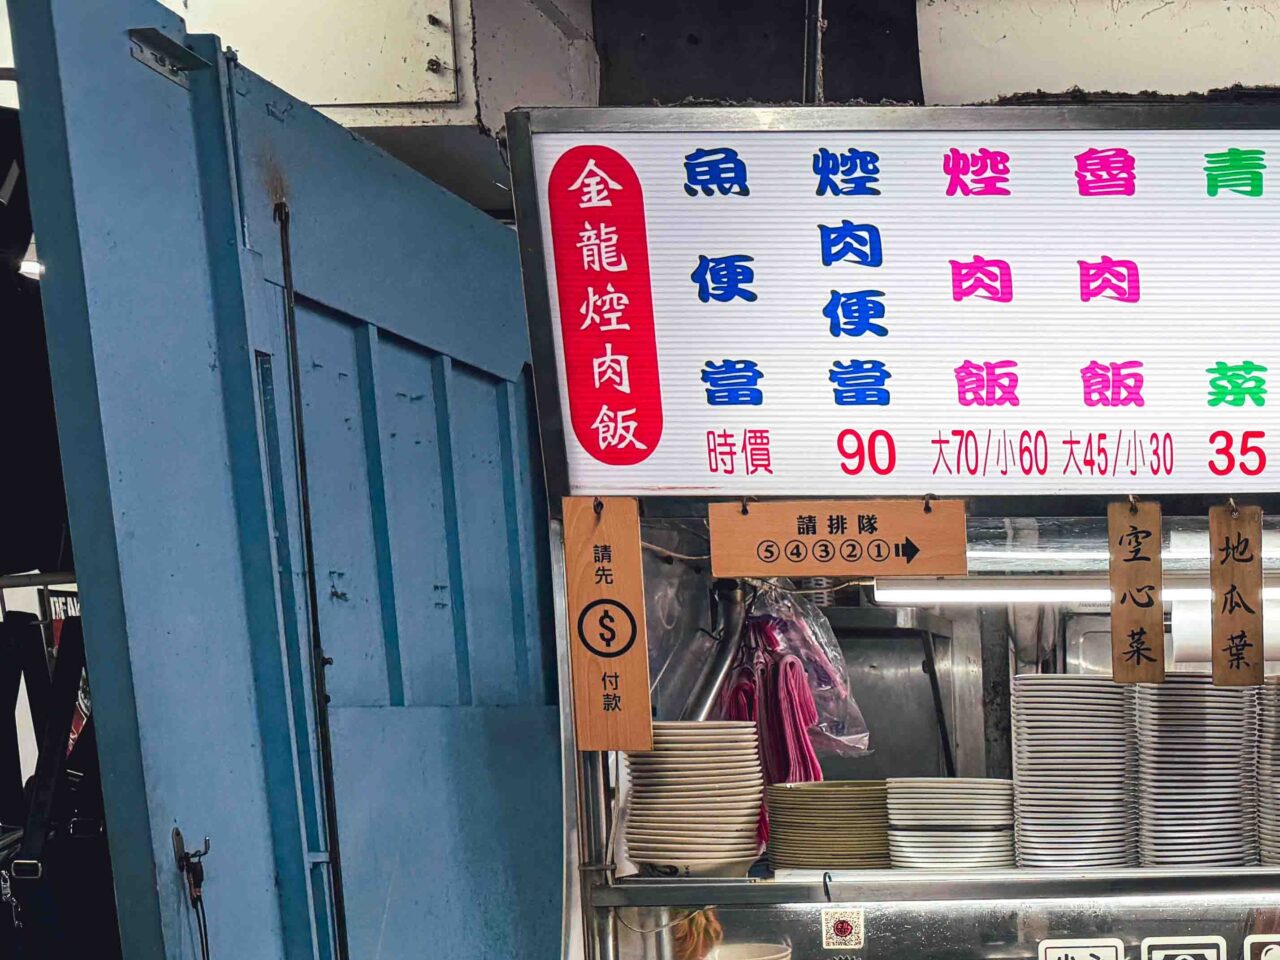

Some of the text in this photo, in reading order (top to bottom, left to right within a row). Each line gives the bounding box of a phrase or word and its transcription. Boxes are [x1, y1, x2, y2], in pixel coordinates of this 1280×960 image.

[568, 158, 646, 451] 金龍焢肉飯
[684, 148, 763, 405] 魚便當
[813, 148, 890, 405] 焢肉便當
[943, 148, 1019, 406] 焢肉飯
[1075, 148, 1144, 406] 魯肉飯
[1204, 148, 1267, 406] 青菜
[707, 430, 772, 474] 時價
[837, 429, 896, 475] 90
[932, 430, 1047, 475] 大70/小60
[1063, 433, 1173, 475] 大45/小30
[1209, 431, 1266, 476] 35
[593, 544, 613, 585] 請先
[797, 515, 878, 535] 請排隊
[1119, 526, 1156, 666] 空心菜
[1219, 533, 1256, 670] 地瓜葉
[602, 672, 621, 711] 付款
